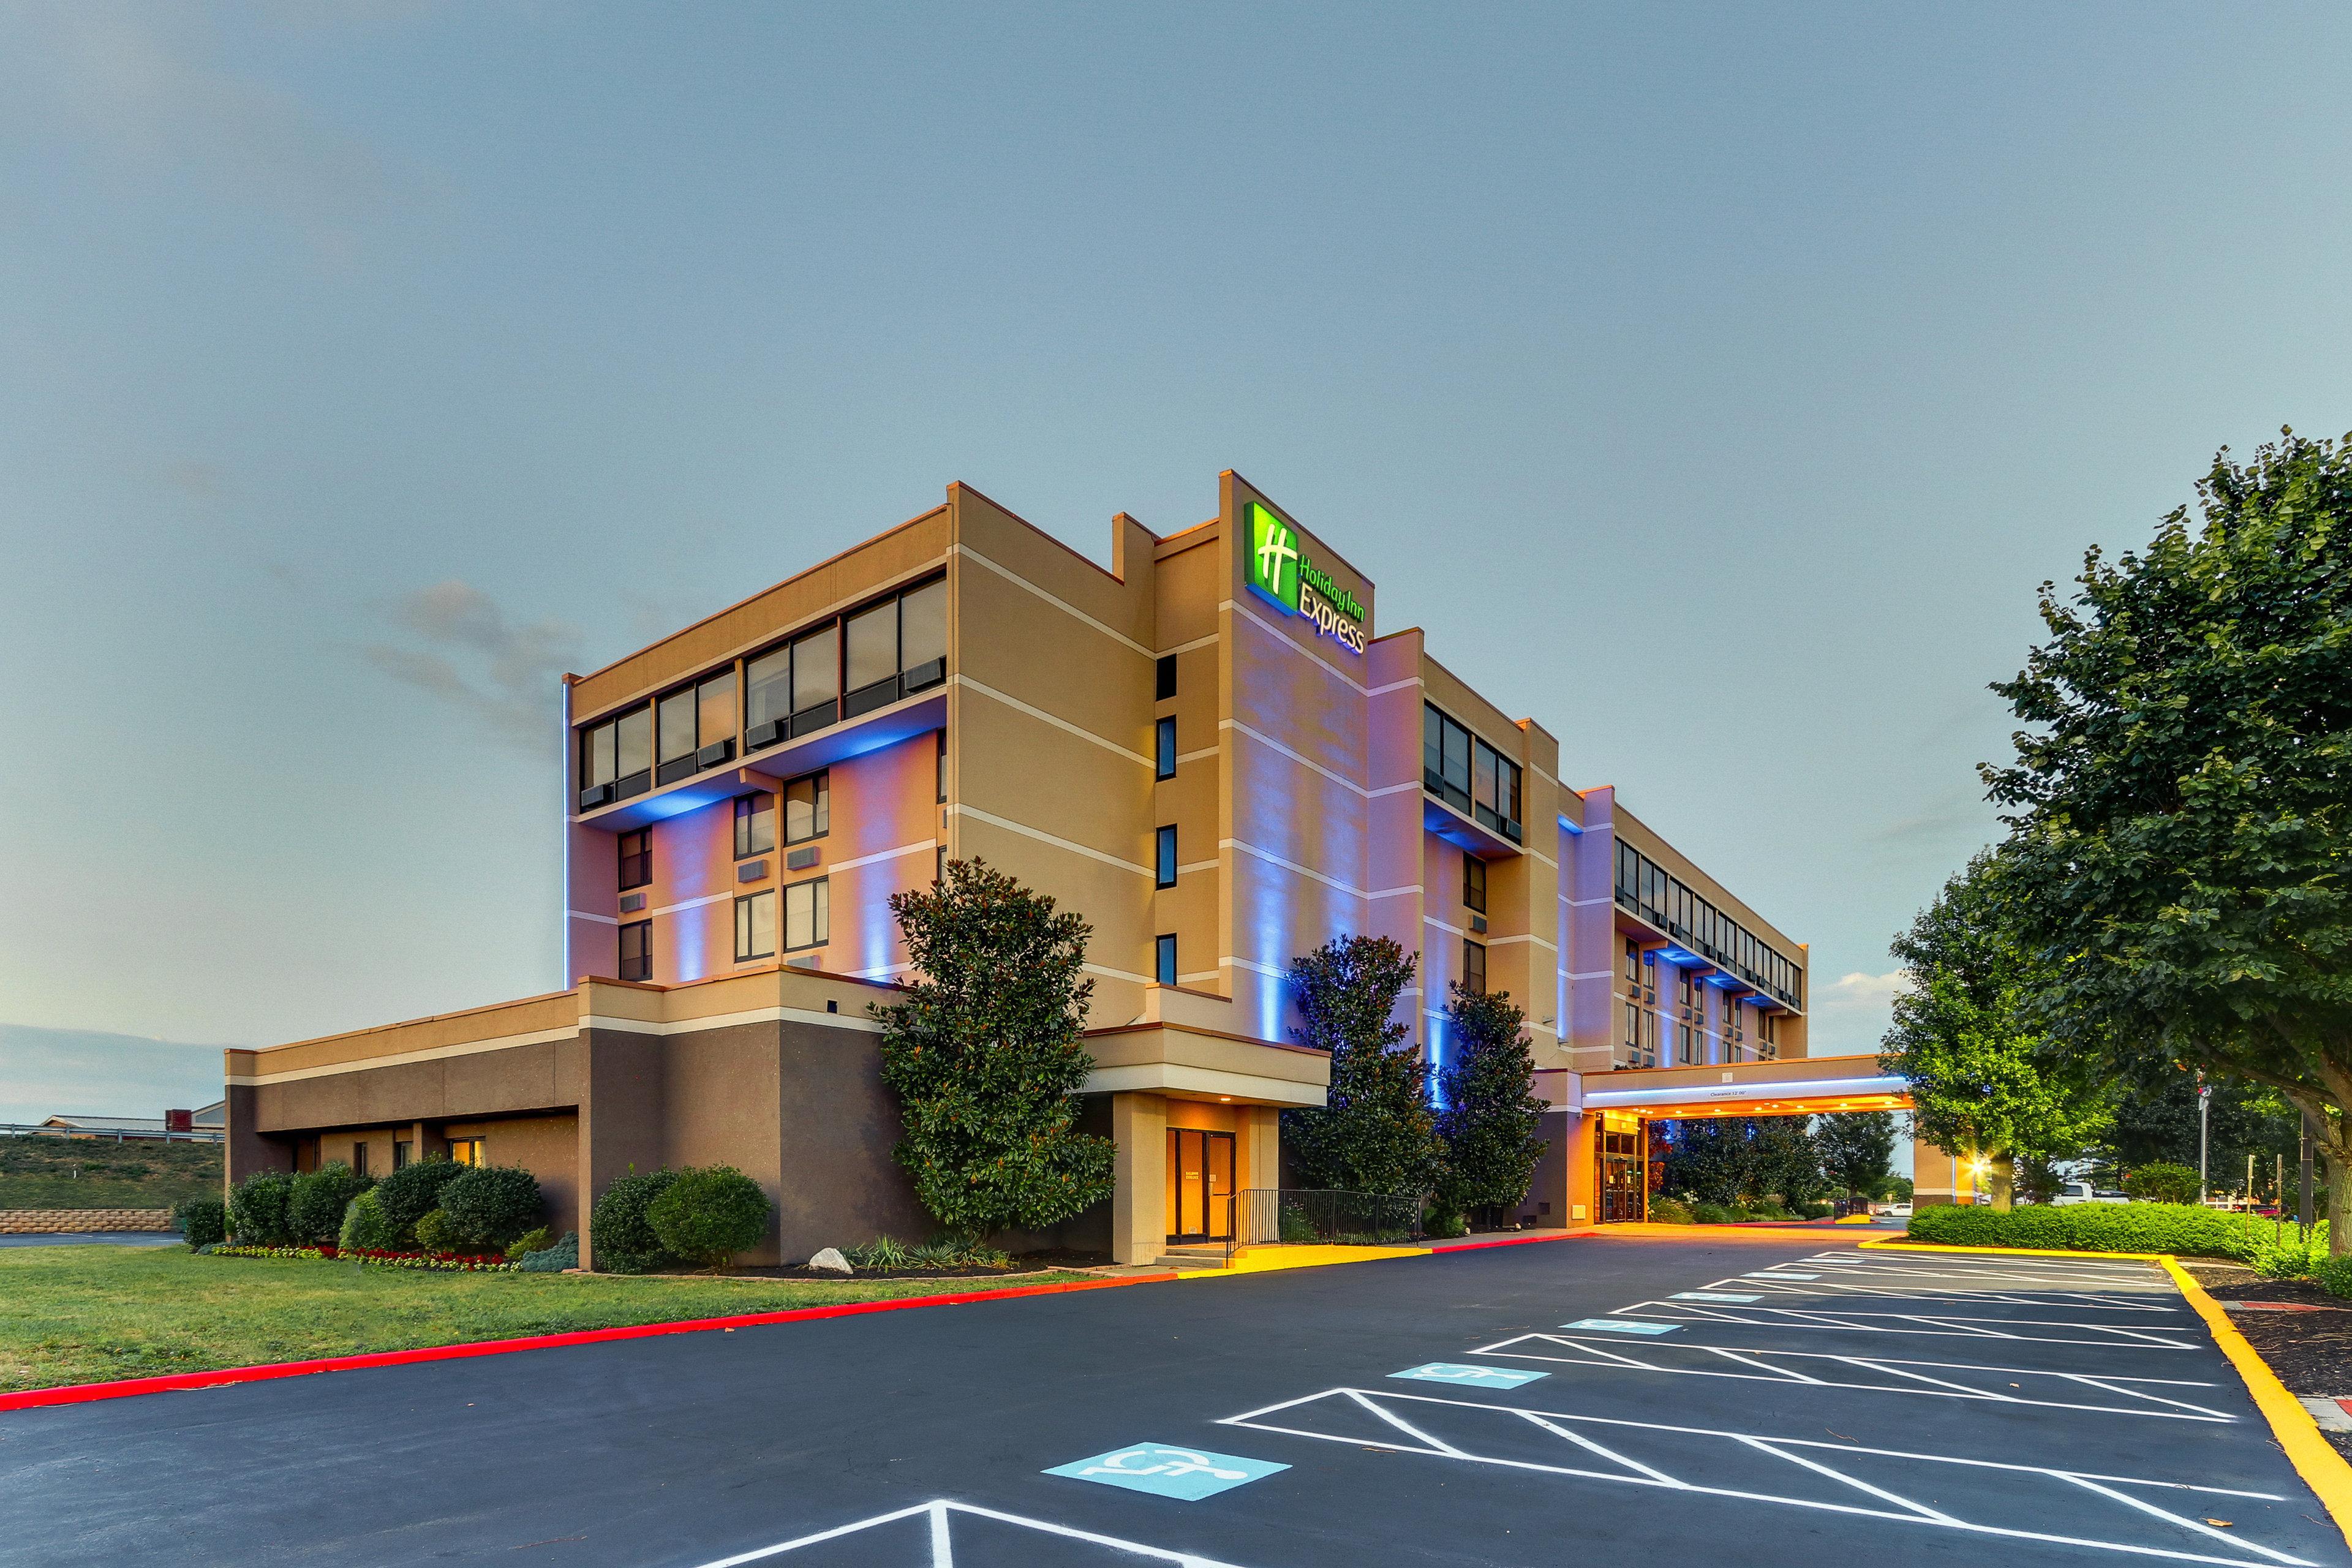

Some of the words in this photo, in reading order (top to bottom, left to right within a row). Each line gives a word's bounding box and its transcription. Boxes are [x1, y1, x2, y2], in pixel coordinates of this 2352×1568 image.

[1299, 581, 1365, 654] Express
[1300, 554, 1345, 611] Holiday
[1347, 590, 1365, 622] Inn
